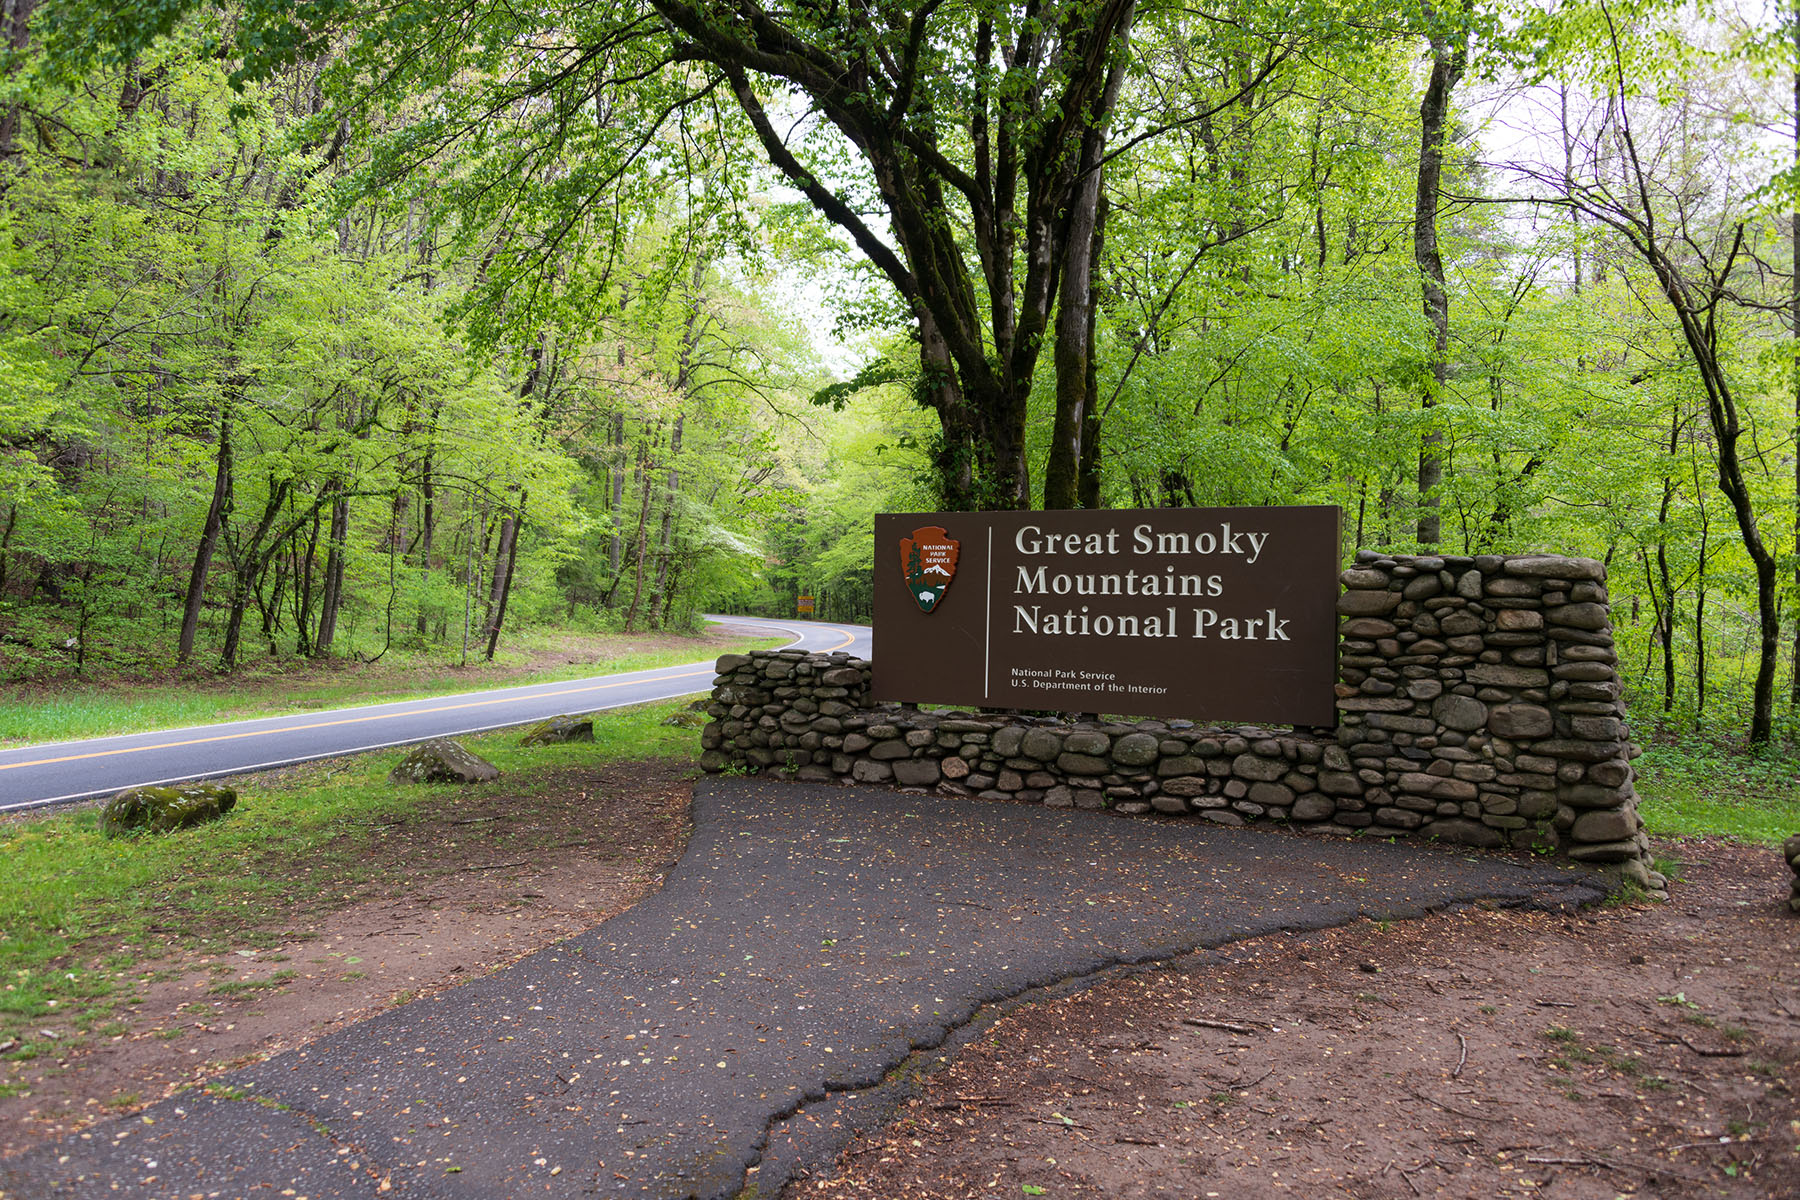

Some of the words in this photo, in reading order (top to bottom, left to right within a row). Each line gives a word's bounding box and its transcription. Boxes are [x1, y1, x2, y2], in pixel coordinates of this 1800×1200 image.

[1015, 525, 1120, 555] Great
[1133, 523, 1270, 564] Smoky
[1014, 565, 1223, 597] Mountains
[1012, 605, 1178, 638] National
[1192, 608, 1291, 641] Park
[1011, 668, 1052, 678] National
[1055, 669, 1076, 679] Park
[1079, 670, 1116, 681] Service
[1011, 679, 1030, 688] U.S.
[1033, 680, 1091, 691] Department
[1094, 682, 1105, 691] of
[1108, 683, 1125, 692] the
[1128, 684, 1168, 694] Interior
